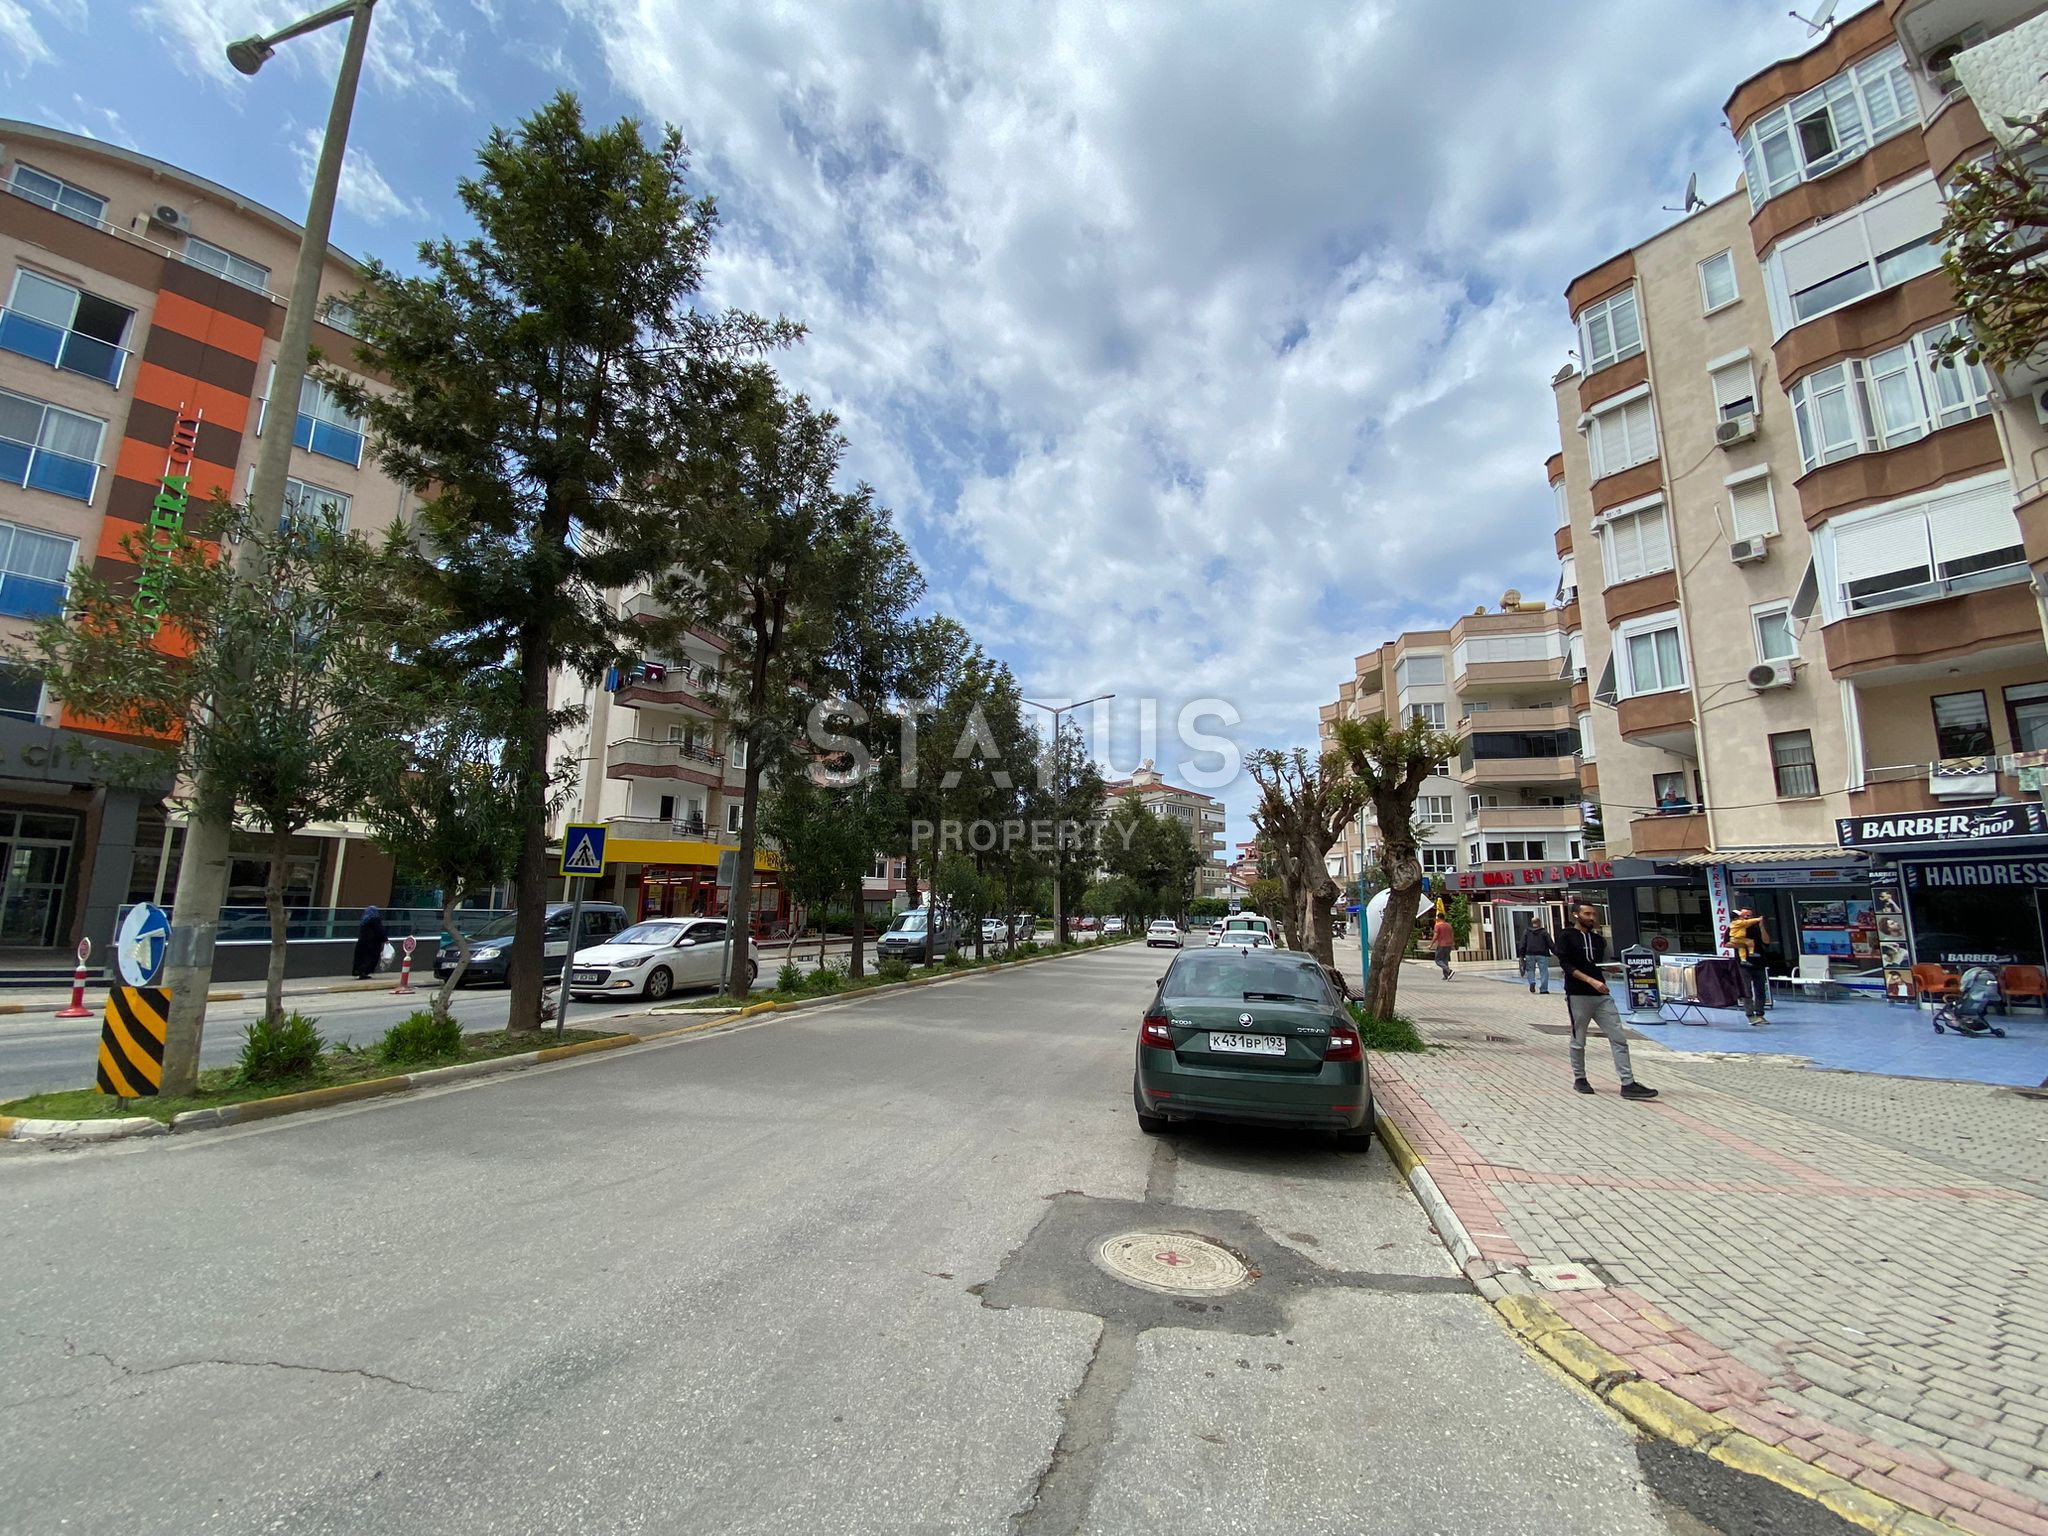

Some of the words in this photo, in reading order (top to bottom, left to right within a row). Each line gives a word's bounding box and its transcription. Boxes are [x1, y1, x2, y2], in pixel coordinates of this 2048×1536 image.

[168, 407, 201, 463] CITY
[1862, 815, 1970, 839] BARBER
[1970, 818, 2014, 838] shop
[1458, 875, 1475, 888] ET
[1523, 868, 1545, 883] ET
[1550, 866, 1561, 881] &
[1925, 863, 2048, 886] HAIRDRESS
[1947, 953, 1998, 963] BARBER
